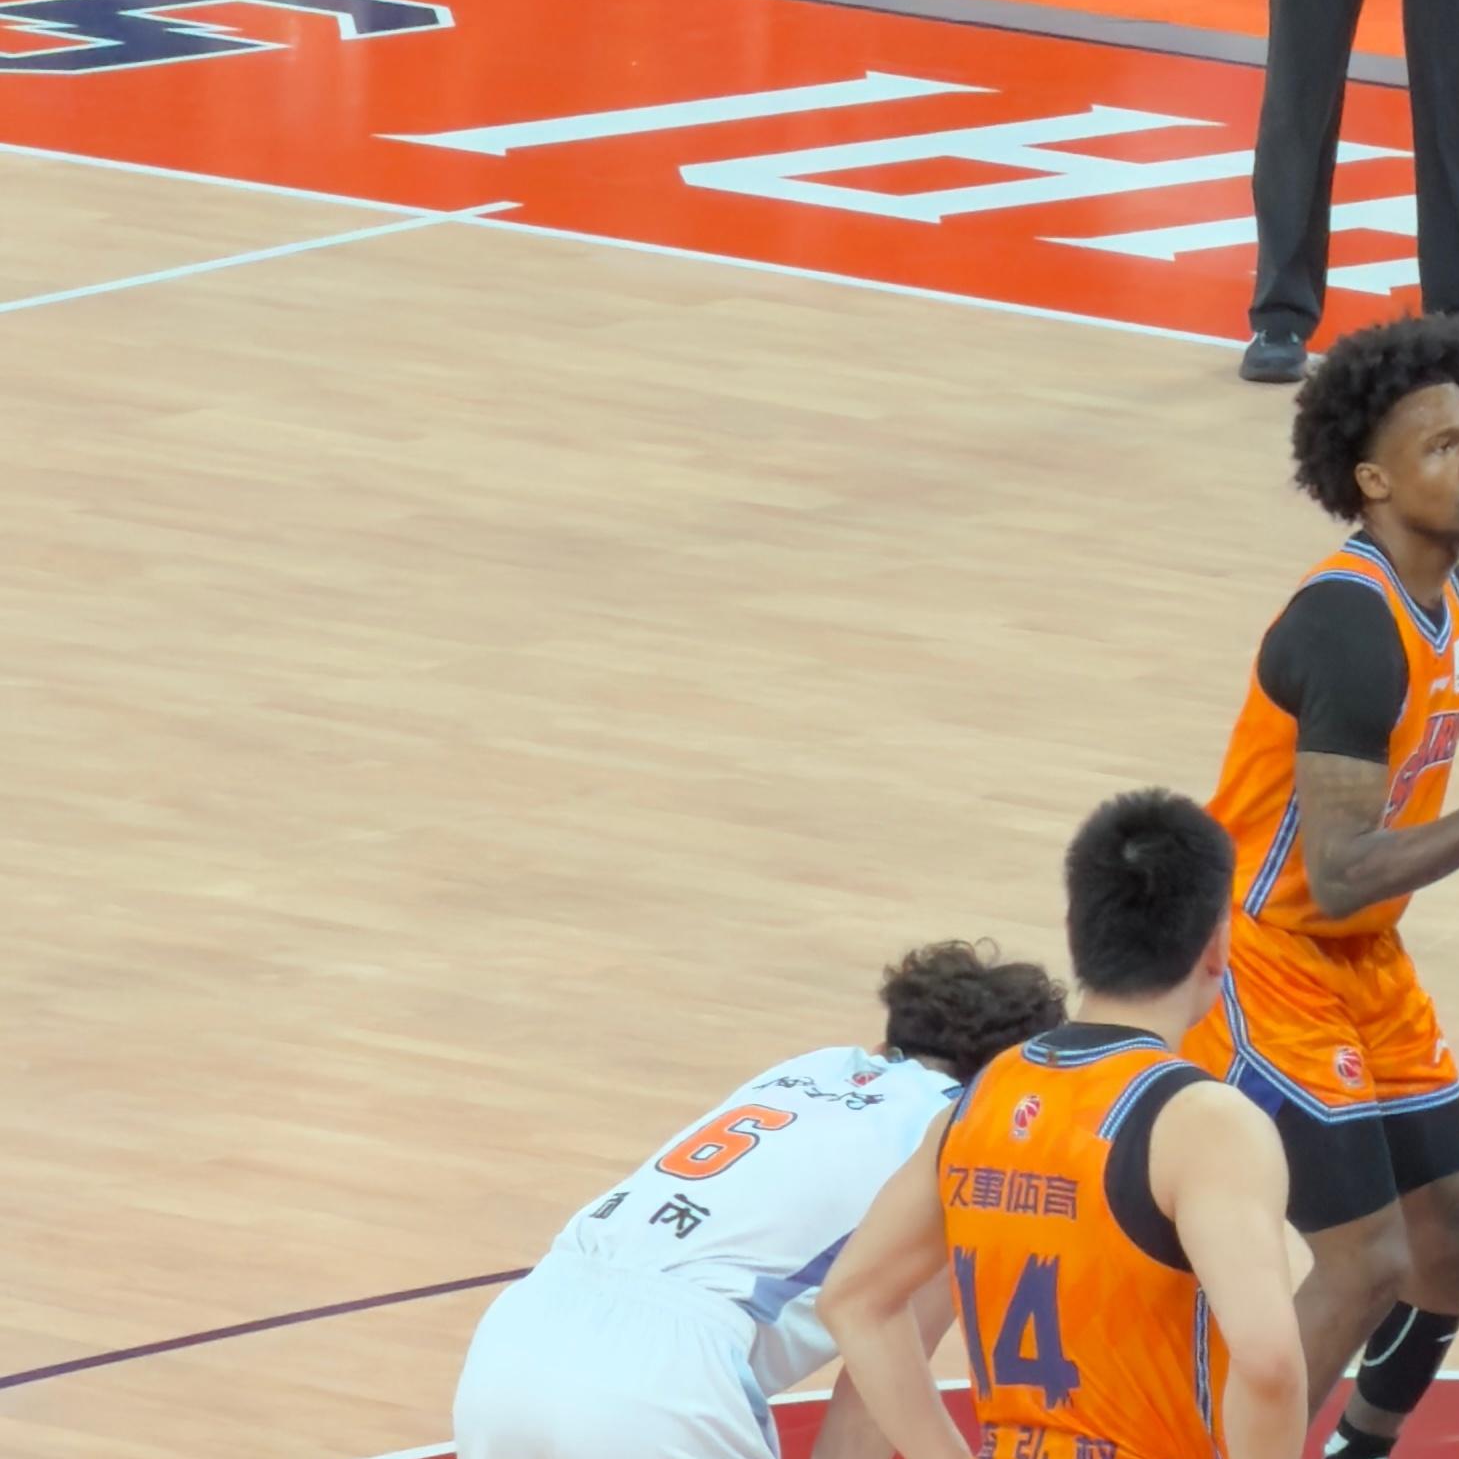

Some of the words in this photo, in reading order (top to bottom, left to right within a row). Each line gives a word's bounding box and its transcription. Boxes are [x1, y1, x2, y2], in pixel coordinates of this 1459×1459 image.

[654, 1103, 798, 1182] 6
[946, 1165, 1080, 1221] 久事体育
[954, 1244, 1081, 1411] 14
